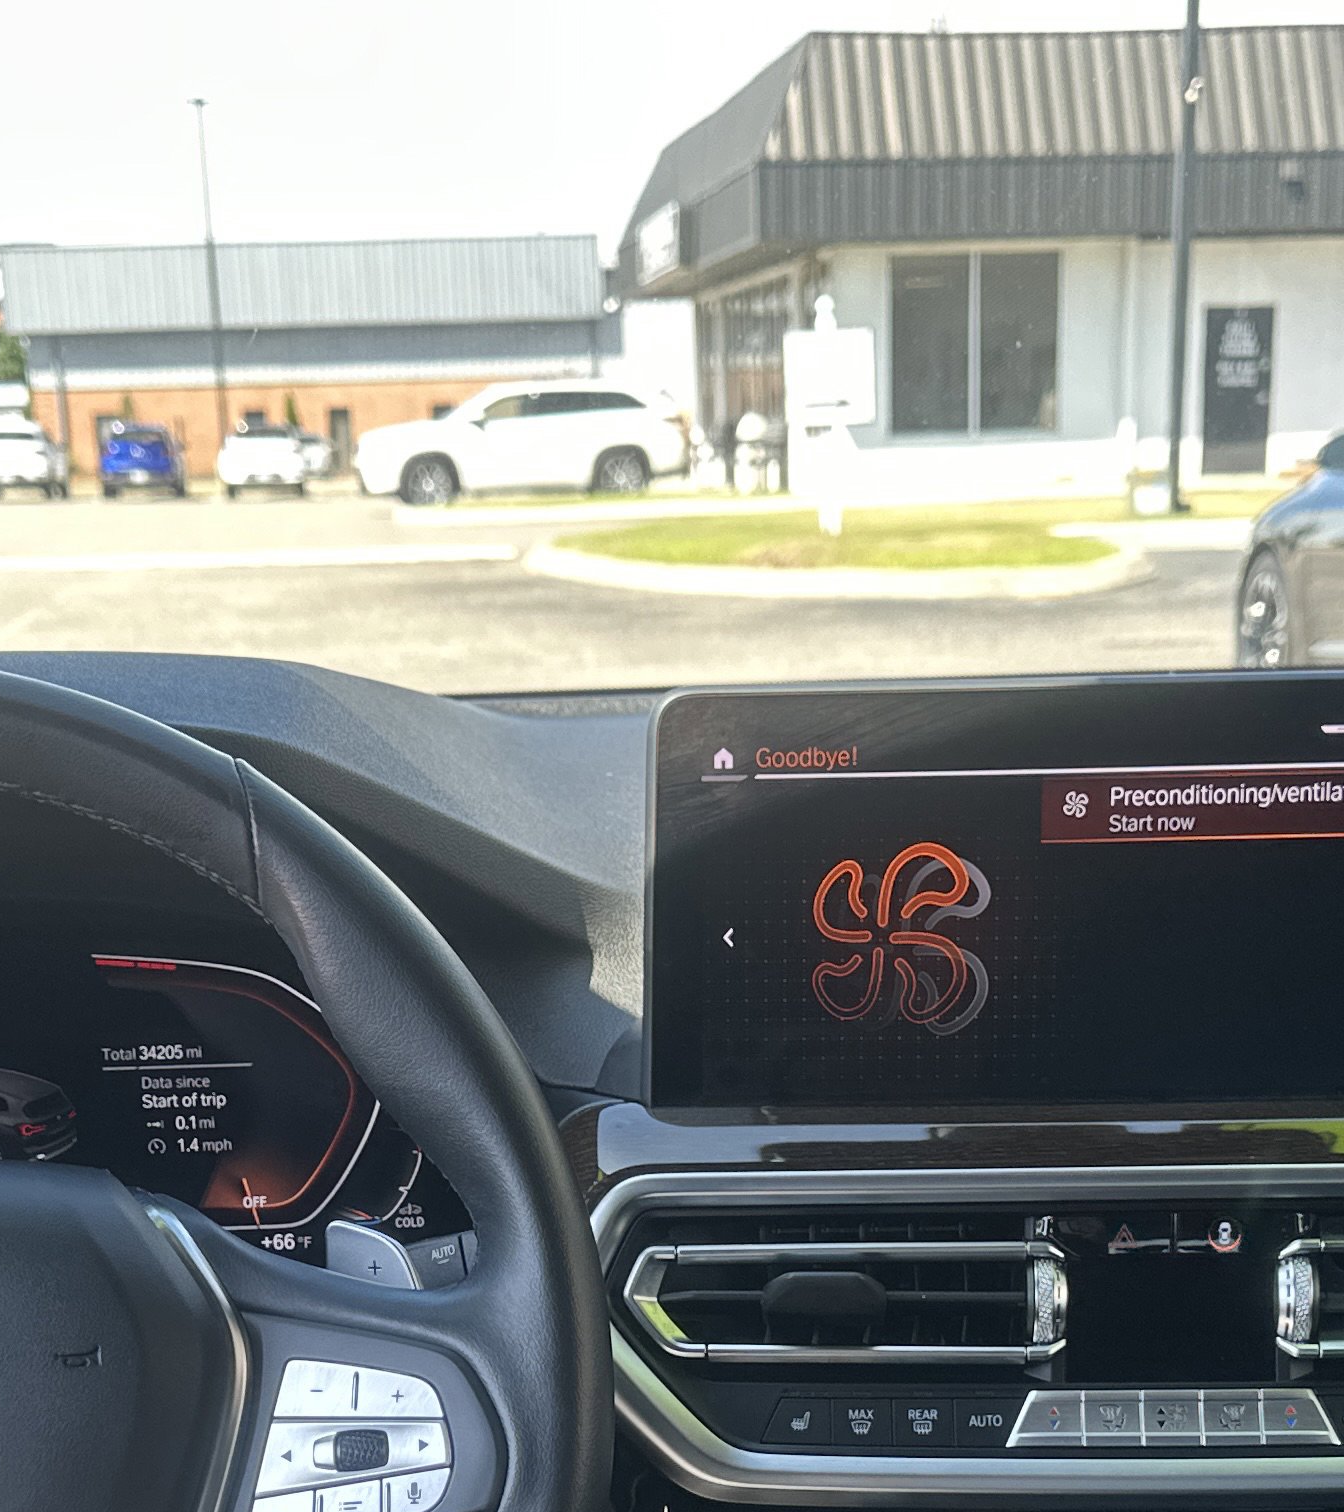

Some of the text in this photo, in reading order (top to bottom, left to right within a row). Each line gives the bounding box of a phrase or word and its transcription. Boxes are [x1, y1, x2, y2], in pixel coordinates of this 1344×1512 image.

[755, 746, 858, 771] Goodbye!
[1108, 813, 1197, 833] Start now
[101, 1044, 203, 1061] Total 34205 mi
[141, 1075, 211, 1090] Data since
[141, 1091, 227, 1110] Start of trip
[175, 1115, 216, 1131] 0.1 mi
[177, 1138, 233, 1154] 1.4 mph
[242, 1195, 267, 1209] OFF
[395, 1216, 425, 1228] COLD
[261, 1233, 296, 1251] +66
[431, 1244, 456, 1261] AUTO
[848, 1408, 874, 1421] MAX
[907, 1408, 939, 1421] REAR
[968, 1414, 1004, 1428] AUTO
